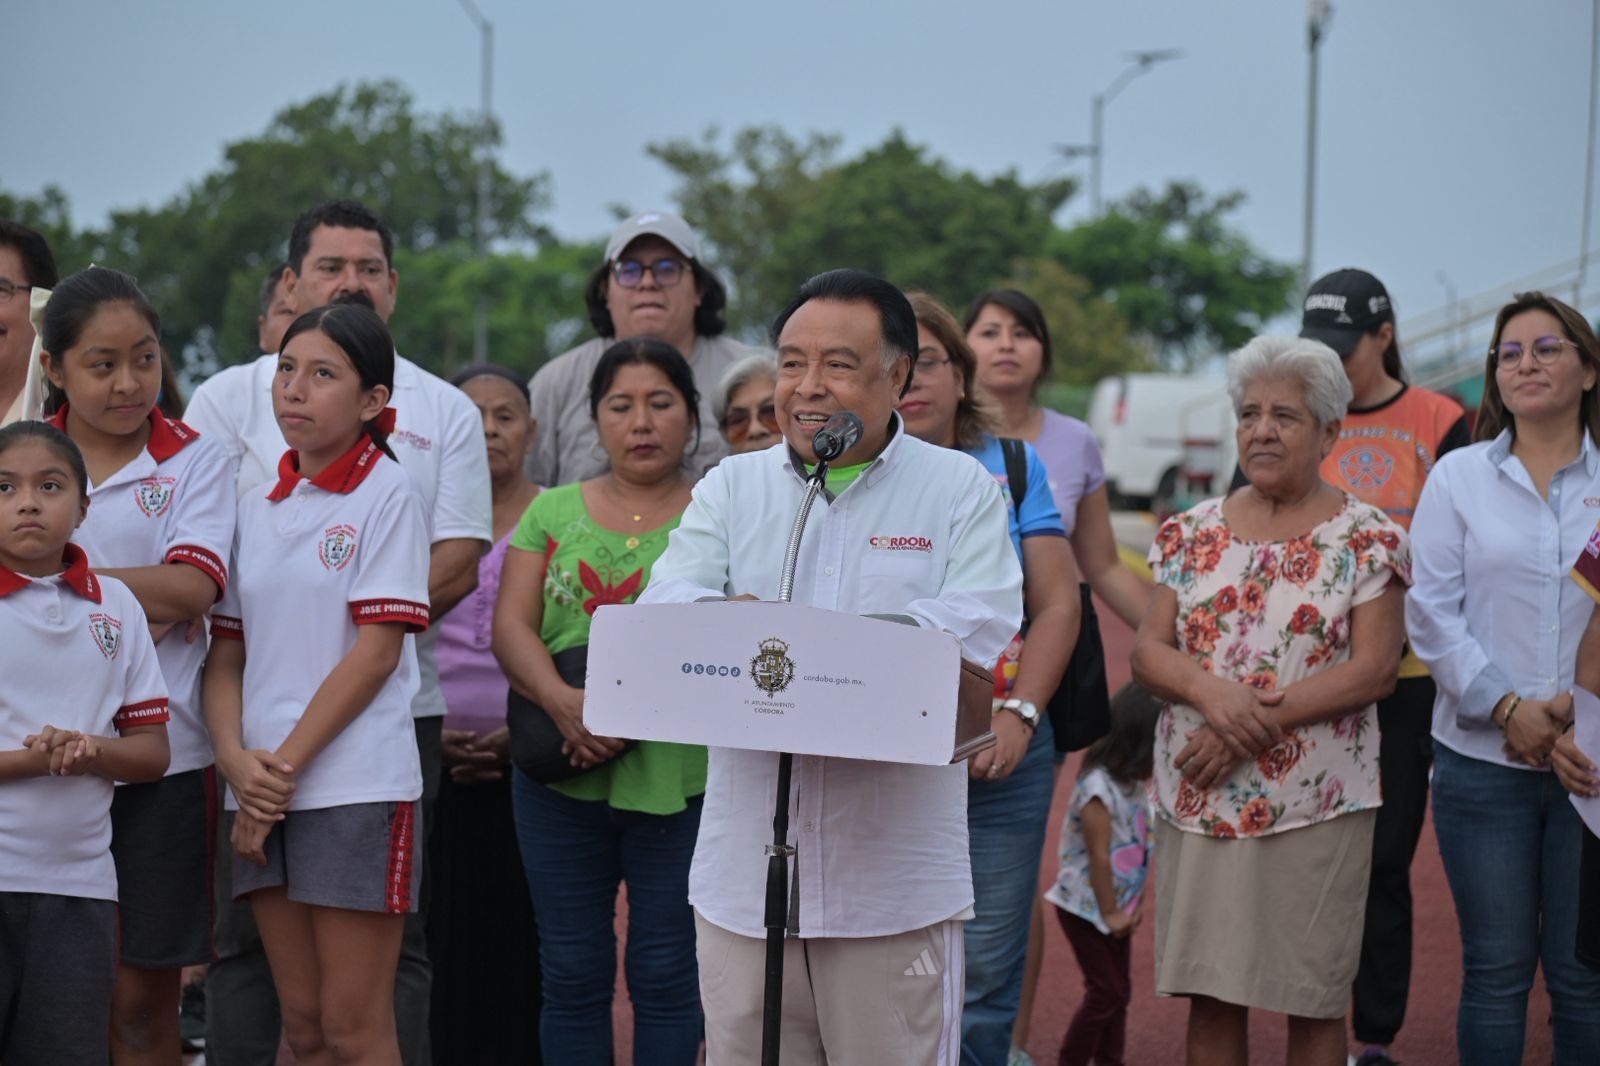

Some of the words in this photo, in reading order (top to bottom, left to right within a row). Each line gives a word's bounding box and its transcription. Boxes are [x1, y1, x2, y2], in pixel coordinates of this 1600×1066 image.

[191, 551, 220, 573] MARIA
[359, 604, 382, 615] JOSE
[383, 603, 414, 614] MARIA
[751, 700, 796, 709] AYUNTAMIENTO
[128, 706, 163, 718] MARIA
